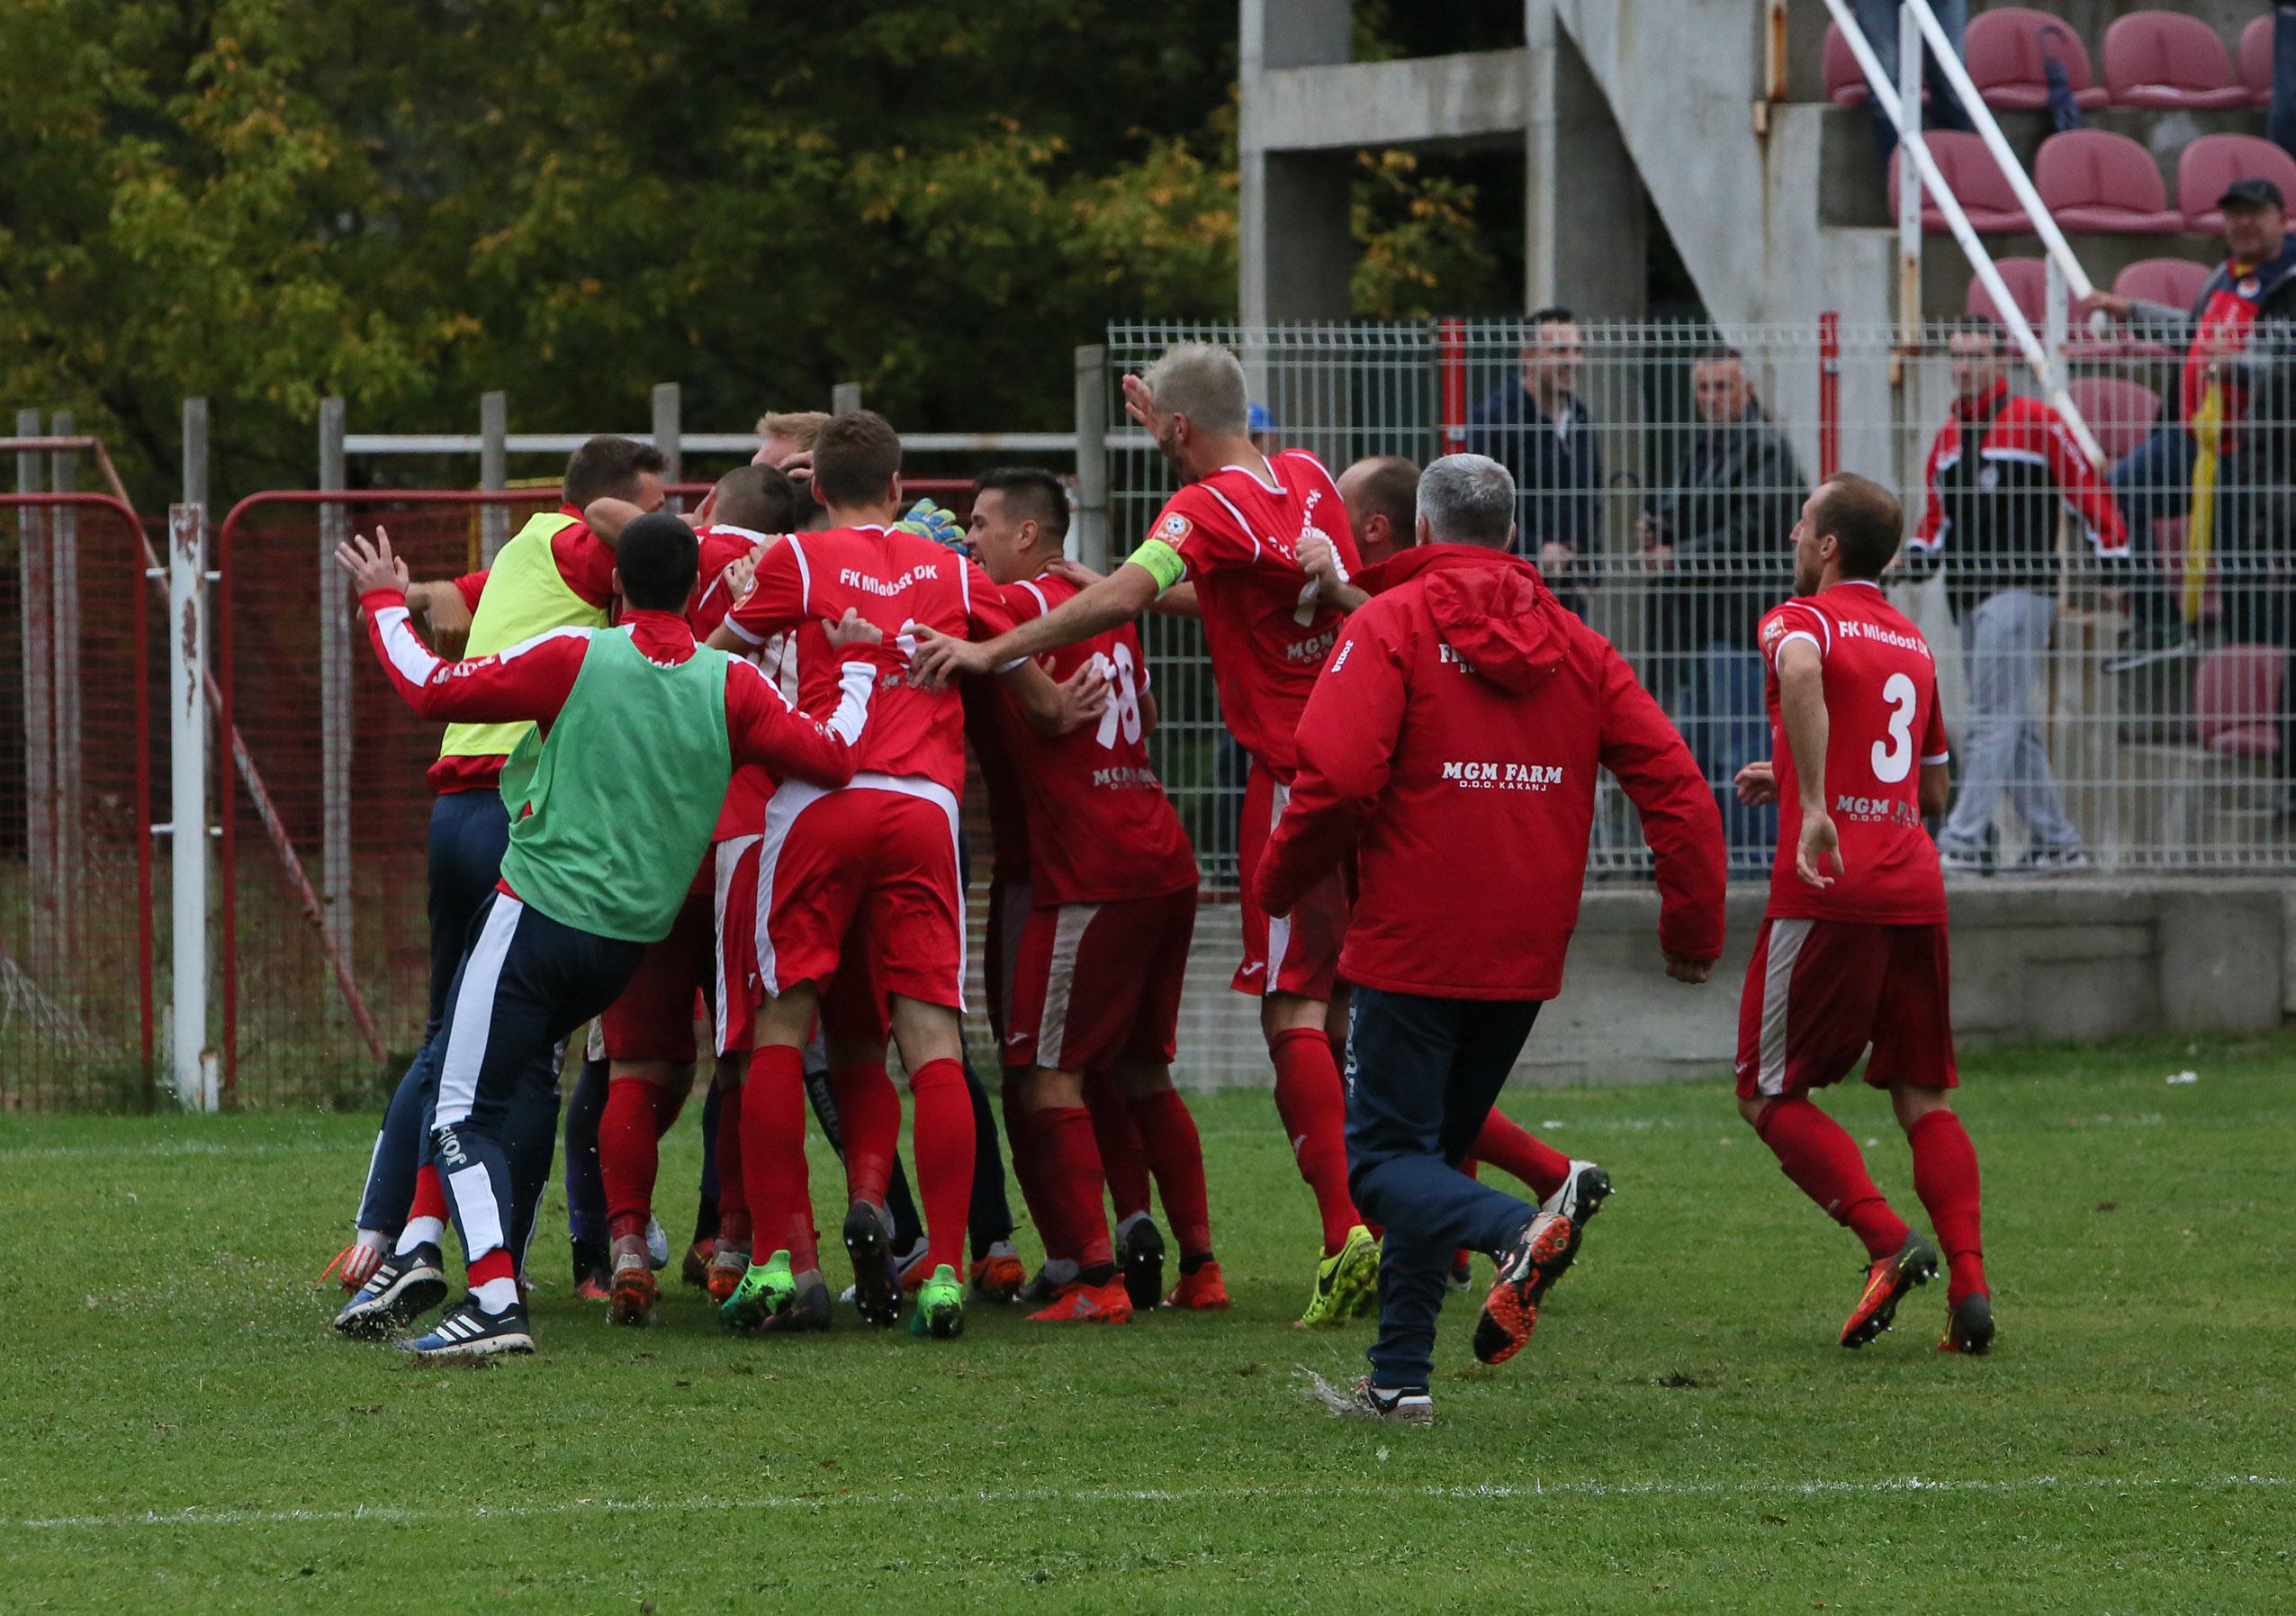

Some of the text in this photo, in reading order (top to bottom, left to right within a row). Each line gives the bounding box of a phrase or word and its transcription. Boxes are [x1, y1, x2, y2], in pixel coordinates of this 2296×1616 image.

[840, 564, 938, 598] FK Mladost DK
[1838, 620, 1862, 638] FK
[1861, 622, 1918, 652] Mladost
[1870, 672, 1917, 784] 3
[1441, 762, 1564, 784] MGM FARM
[1458, 780, 1547, 792] D.O.O. KAKANJ
[1835, 794, 1890, 815] MGM
